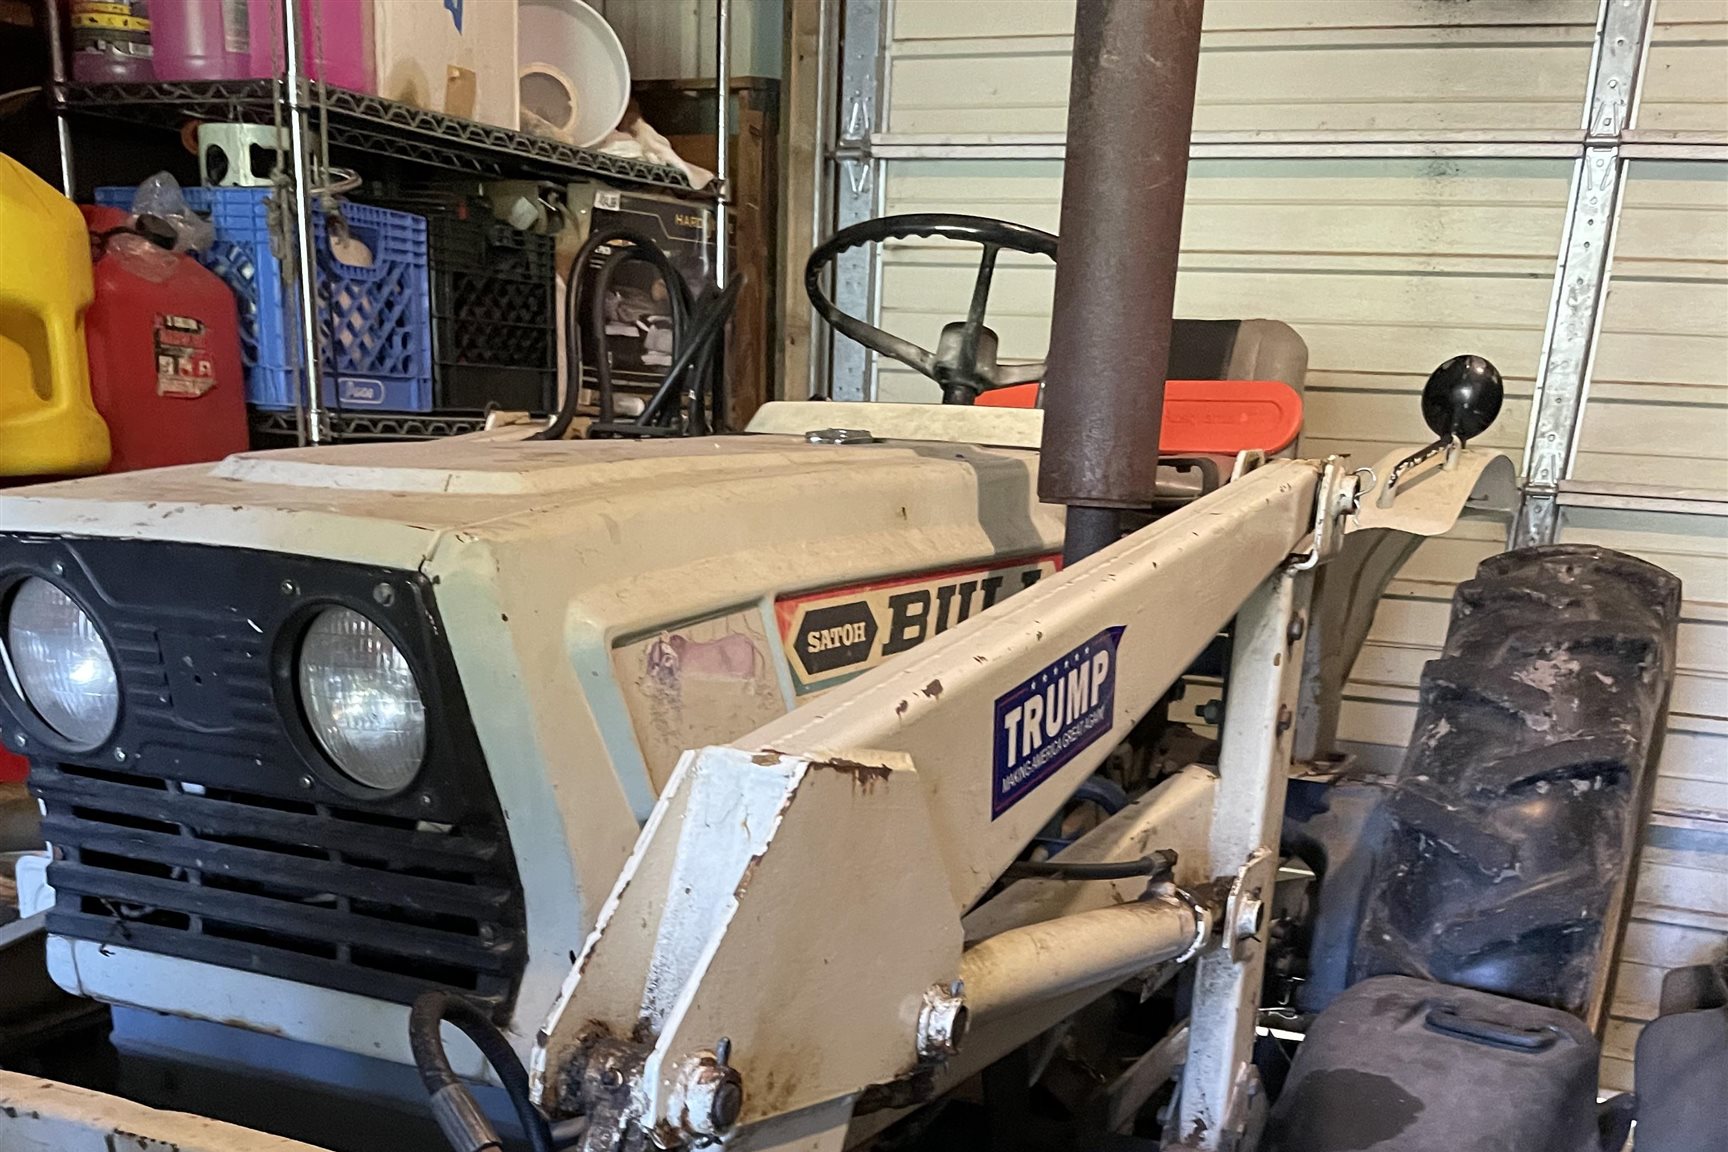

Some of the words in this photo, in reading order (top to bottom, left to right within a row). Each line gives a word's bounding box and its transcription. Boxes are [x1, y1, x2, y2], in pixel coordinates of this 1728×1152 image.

[807, 622, 866, 653] SATOH
[882, 569, 1042, 657] BU
[1004, 649, 1109, 768] TRUMP
[1032, 738, 1062, 768] AMERICA
[1061, 720, 1084, 748] GREAT
